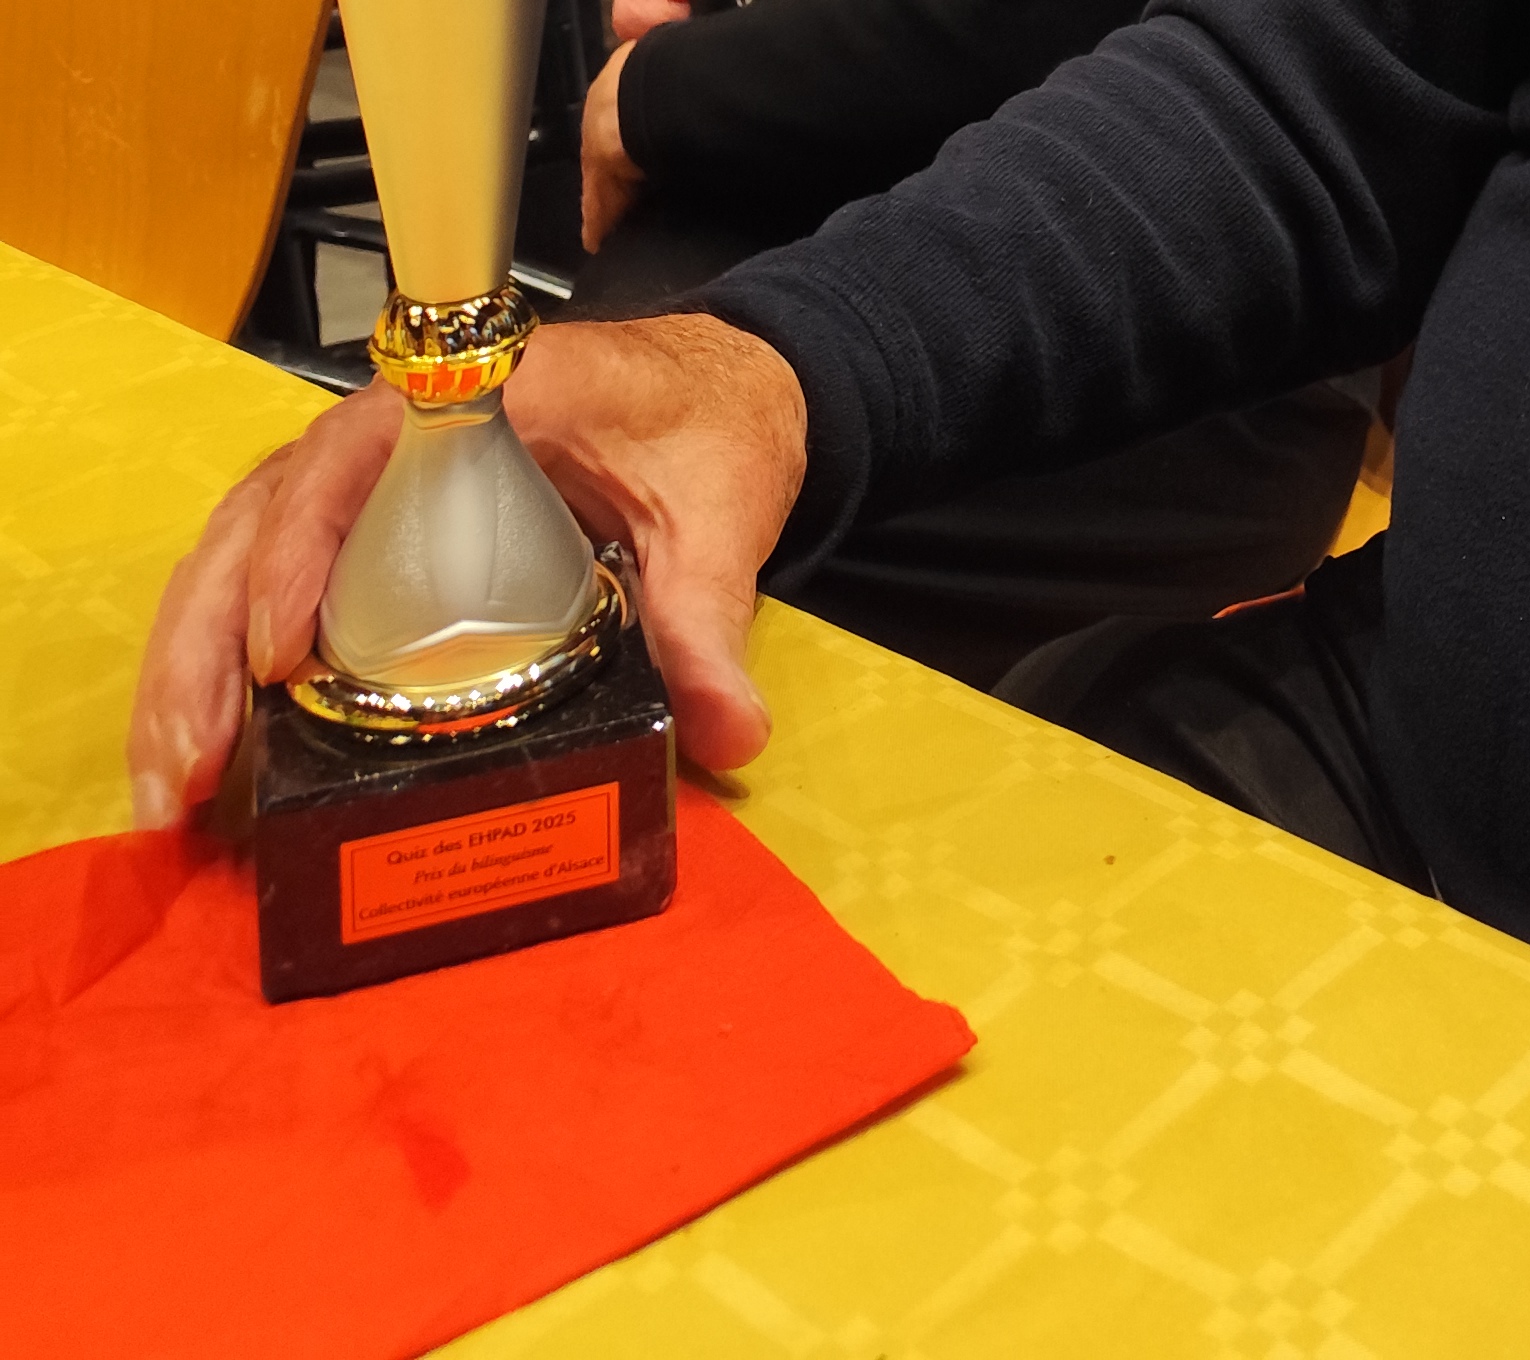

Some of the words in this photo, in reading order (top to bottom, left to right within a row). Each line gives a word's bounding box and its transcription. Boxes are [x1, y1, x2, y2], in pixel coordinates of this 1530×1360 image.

[386, 849, 428, 866] Quiz
[433, 838, 463, 854] des
[468, 822, 527, 847] EHPAD
[532, 810, 577, 833] 2025
[414, 867, 443, 885] Prix
[447, 860, 466, 877] du
[472, 844, 554, 872] bilinguisme
[358, 889, 444, 921] Collectivité
[448, 869, 540, 899] européenne
[543, 853, 605, 878] d'Alsace
